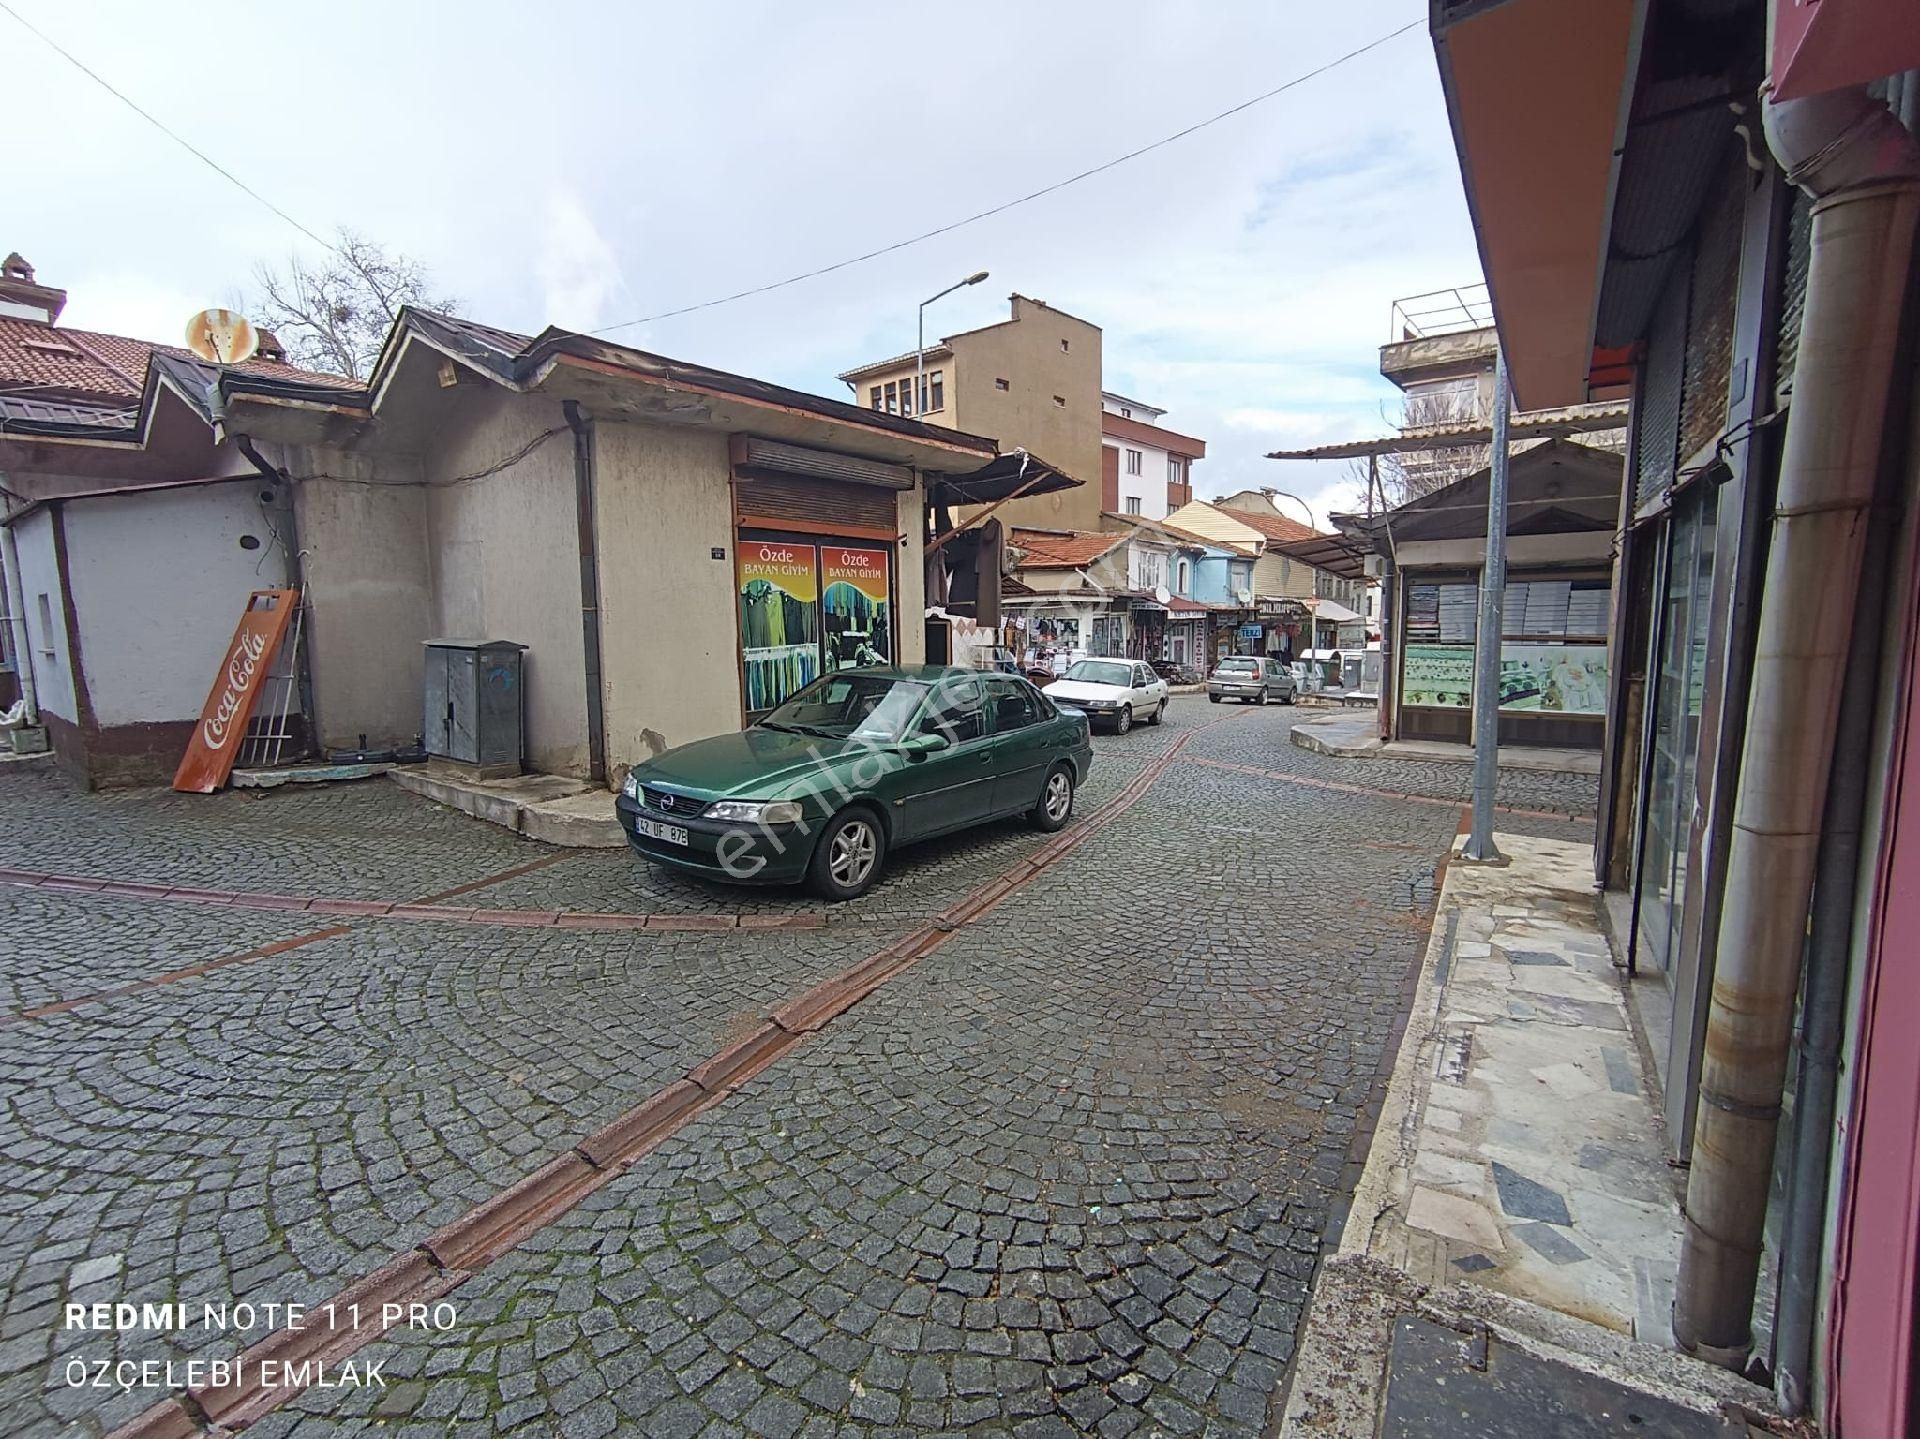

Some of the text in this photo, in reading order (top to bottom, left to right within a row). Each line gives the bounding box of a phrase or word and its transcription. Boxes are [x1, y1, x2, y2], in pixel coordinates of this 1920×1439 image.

[760, 545, 794, 563] Özde
[841, 551, 869, 566] Özde
[744, 564, 808, 576] BAYAN GİYİM
[829, 568, 881, 578] BAYAN GİYİM
[204, 627, 266, 750] Coca-Cola
[640, 820, 649, 833] 42
[653, 822, 664, 837] UF
